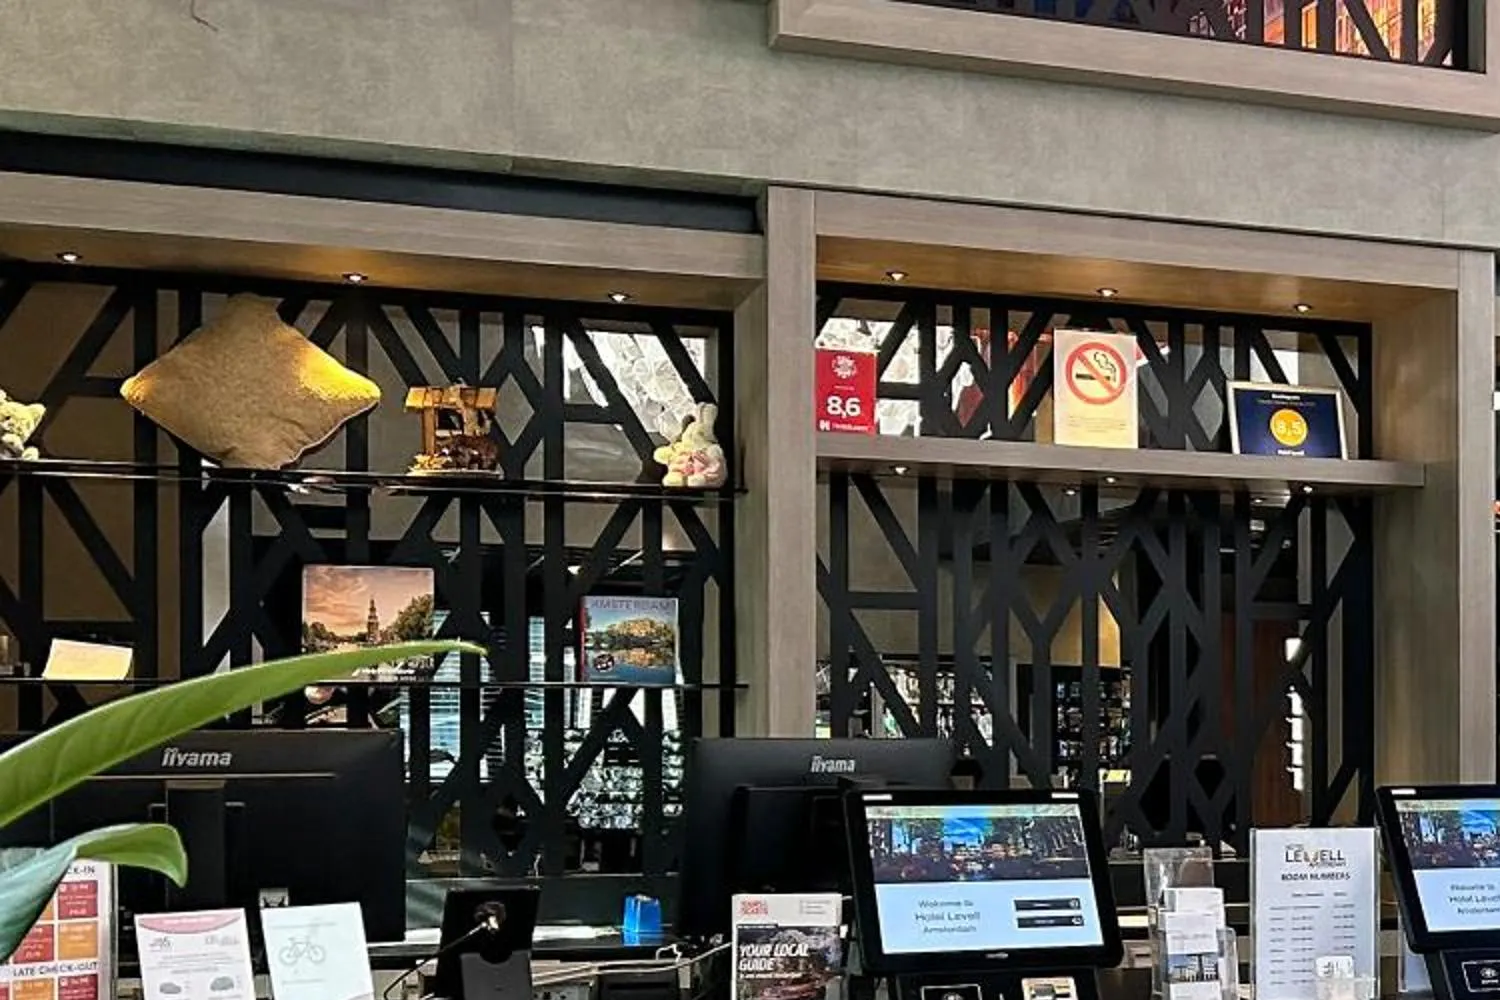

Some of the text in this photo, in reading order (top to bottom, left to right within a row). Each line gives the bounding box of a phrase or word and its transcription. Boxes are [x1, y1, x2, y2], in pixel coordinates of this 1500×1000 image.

[827, 395, 861, 419] 8,6
[739, 943, 809, 957] YOUR LOCAL
[738, 959, 775, 971] GUIDE
